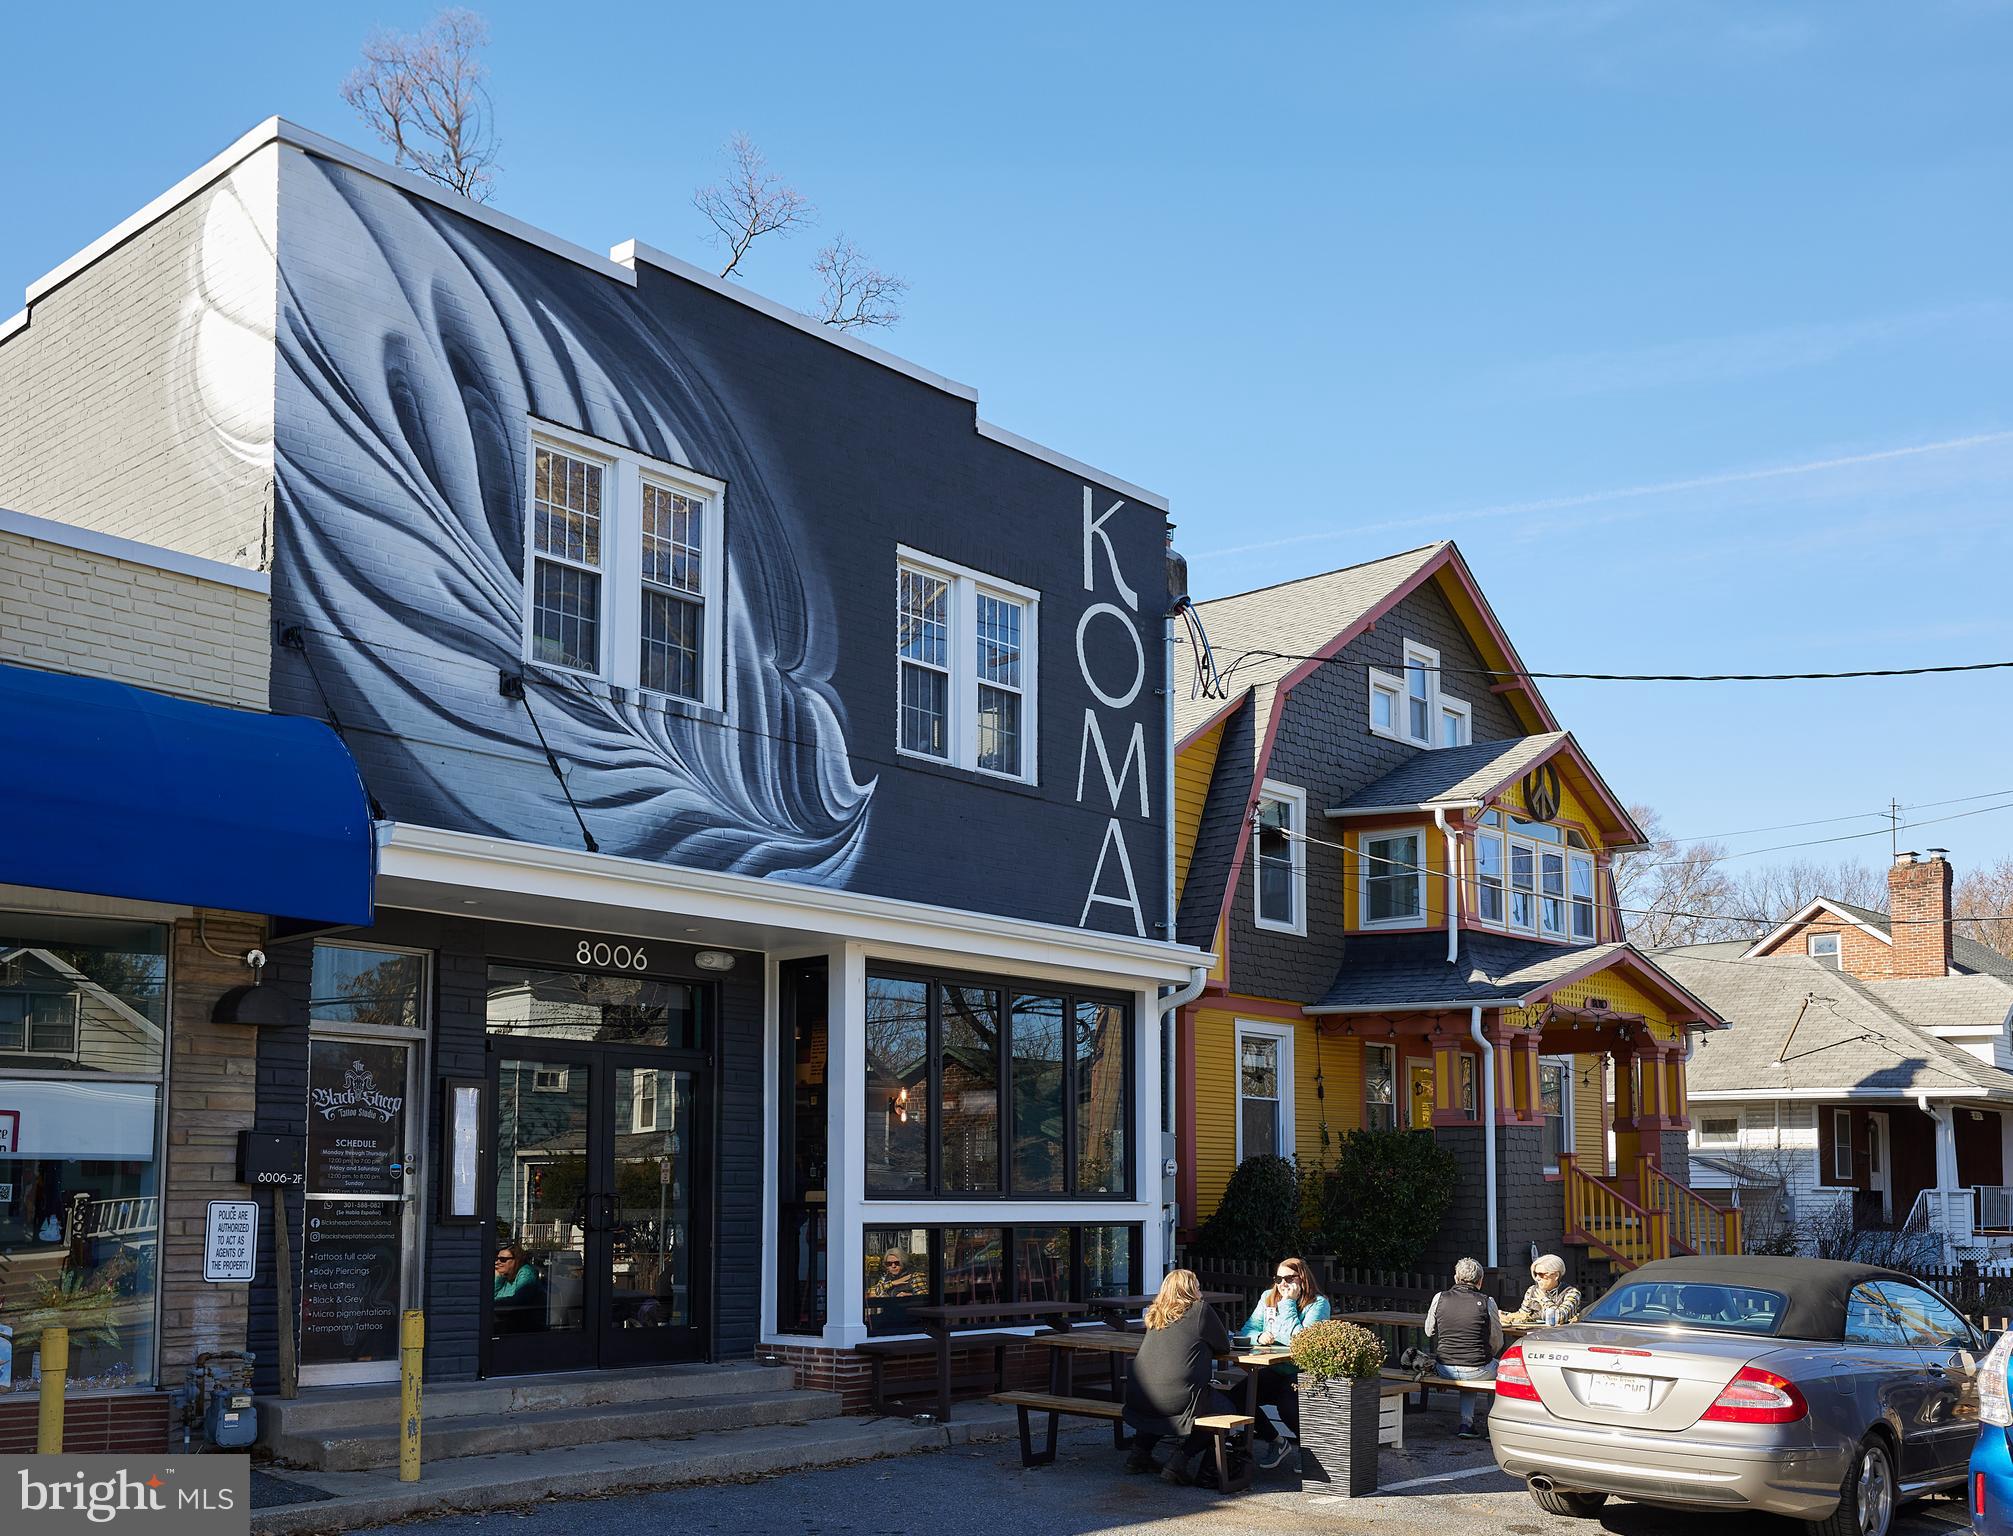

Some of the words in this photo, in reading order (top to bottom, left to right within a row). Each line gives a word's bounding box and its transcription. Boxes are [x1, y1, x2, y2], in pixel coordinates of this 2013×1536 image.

[1076, 486, 1150, 938] KOMA
[576, 940, 648, 971] 8006
[353, 1060, 365, 1071] The
[312, 1088, 355, 1107] Black
[362, 1090, 402, 1114] Sheep
[338, 1108, 357, 1118] Tattoo
[358, 1108, 377, 1119] Studio
[335, 1139, 377, 1148] SCHEDULE
[344, 1149, 365, 1157] through
[258, 1172, 303, 1184] 8006-2F
[219, 1210, 236, 1220] POLICE
[238, 1210, 248, 1220] ARE
[217, 1223, 250, 1233] AUTHORIZED
[217, 1235, 225, 1245] TO
[226, 1235, 237, 1245] ACT
[237, 1235, 245, 1245] AS
[215, 1248, 236, 1258] AGENTS
[237, 1248, 245, 1258] OF
[314, 1253, 342, 1261] Tattoos
[344, 1252, 356, 1261] full
[356, 1253, 377, 1261] color
[211, 1260, 222, 1270] THE
[222, 1260, 250, 1270] PROPERTY
[313, 1267, 334, 1277] Body
[335, 1267, 370, 1277] Piercings
[313, 1282, 328, 1291] Eye
[329, 1282, 355, 1290] Lashes
[312, 1296, 334, 1304] Black
[344, 1295, 363, 1304] Grey
[312, 1310, 337, 1318] Micro
[336, 1308, 392, 1319] pigmentations
[312, 1323, 353, 1334] Temporary
[355, 1322, 383, 1330] Tattoos
